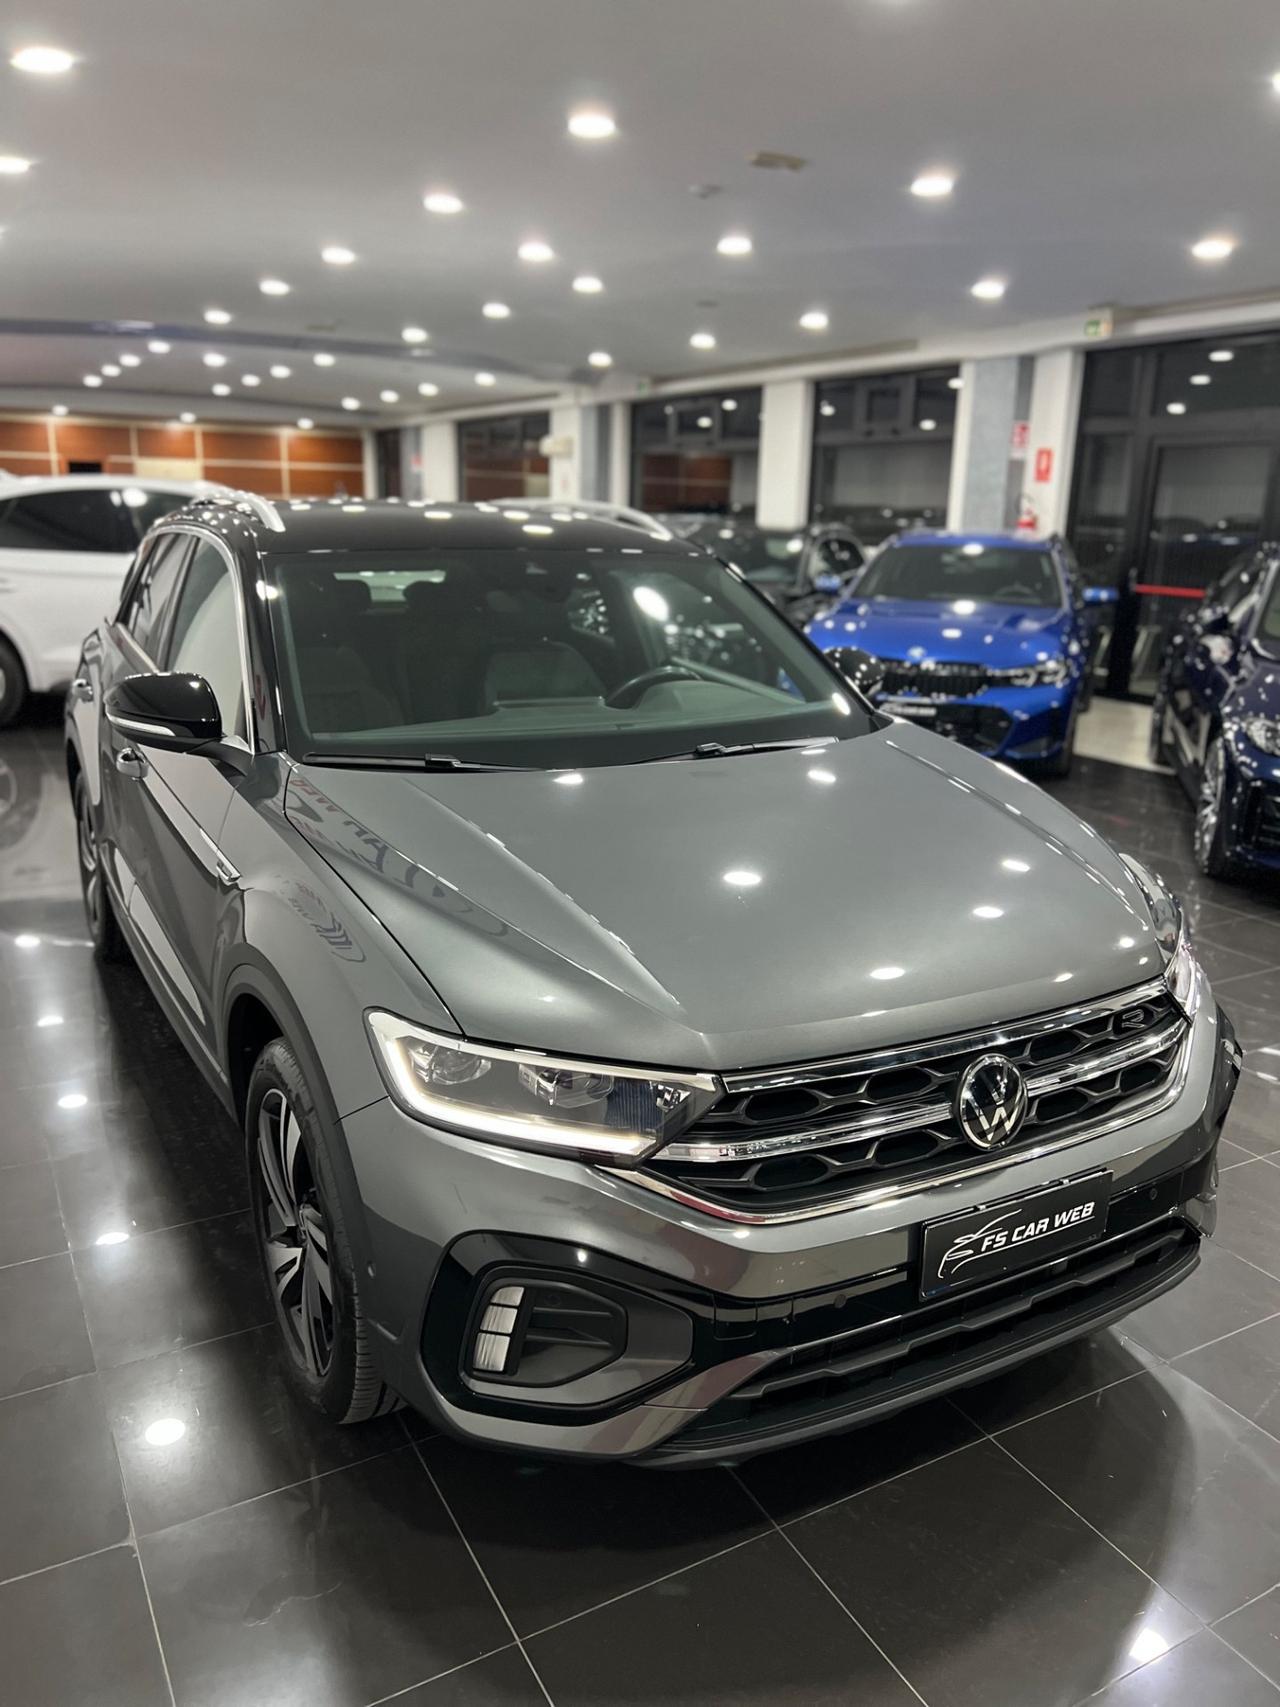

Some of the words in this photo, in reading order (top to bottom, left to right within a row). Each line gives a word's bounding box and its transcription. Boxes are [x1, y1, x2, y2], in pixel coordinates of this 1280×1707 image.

[1122, 1009, 1147, 1028] R
[980, 1231, 1009, 1252] FS
[1011, 1217, 1050, 1243] CAR
[1054, 1201, 1095, 1228] WEB
